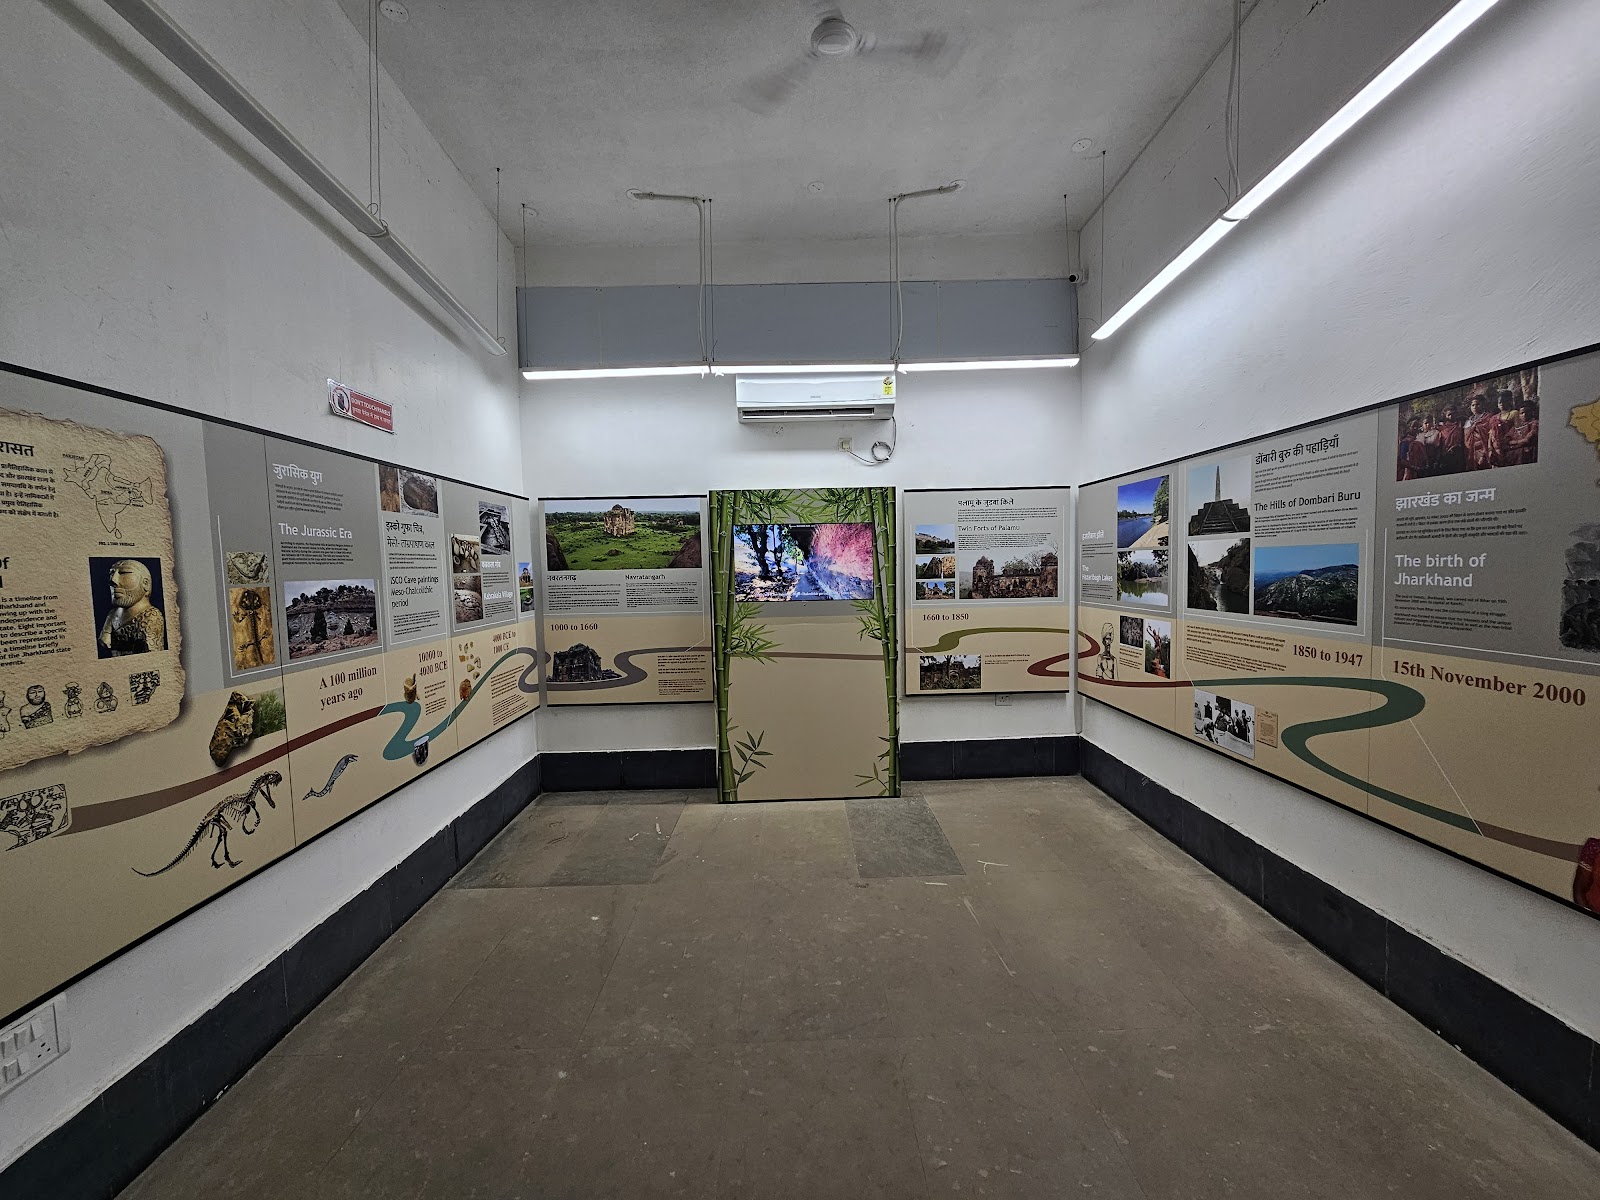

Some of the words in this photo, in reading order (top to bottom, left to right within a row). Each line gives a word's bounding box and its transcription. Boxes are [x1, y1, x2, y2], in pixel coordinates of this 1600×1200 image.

[1256, 450, 1277, 464] डोंबारी
[1293, 443, 1304, 456] की
[1306, 434, 1339, 453] पहाड़ियाँ
[272, 463, 308, 479] जुरासिक
[310, 470, 322, 485] युग
[1254, 502, 1268, 511] The
[1270, 499, 1286, 509] Hills
[1288, 498, 1297, 508] of
[1299, 492, 1336, 506] Dombari
[1338, 490, 1360, 501] Buru
[1395, 491, 1440, 511] झारखंड
[1444, 490, 1462, 505] का
[1466, 487, 1496, 503] जन्म
[278, 523, 298, 536] The
[301, 525, 337, 538] Jurassic
[339, 528, 352, 538] Era
[0, 557, 10, 569] f
[1394, 554, 1421, 568] The
[1426, 554, 1463, 568] birth
[1469, 553, 1487, 568] of
[418, 576, 439, 585] paintings
[1394, 573, 1473, 587] Jharkhand
[392, 599, 408, 609] period
[952, 612, 969, 620] 1850
[20, 635, 58, 644] represented
[22, 649, 54, 657] Jharkhand
[1292, 644, 1317, 659] 1850
[1320, 651, 1331, 662] to
[1335, 651, 1363, 667] 1947
[435, 660, 448, 672] BCE
[320, 677, 327, 689] A
[331, 672, 345, 686] 100
[348, 666, 377, 682] million
[1392, 660, 1425, 678] 15th
[1430, 665, 1527, 696] November
[1533, 682, 1586, 706] 2000
[321, 690, 346, 710] years
[348, 688, 363, 700] ago
